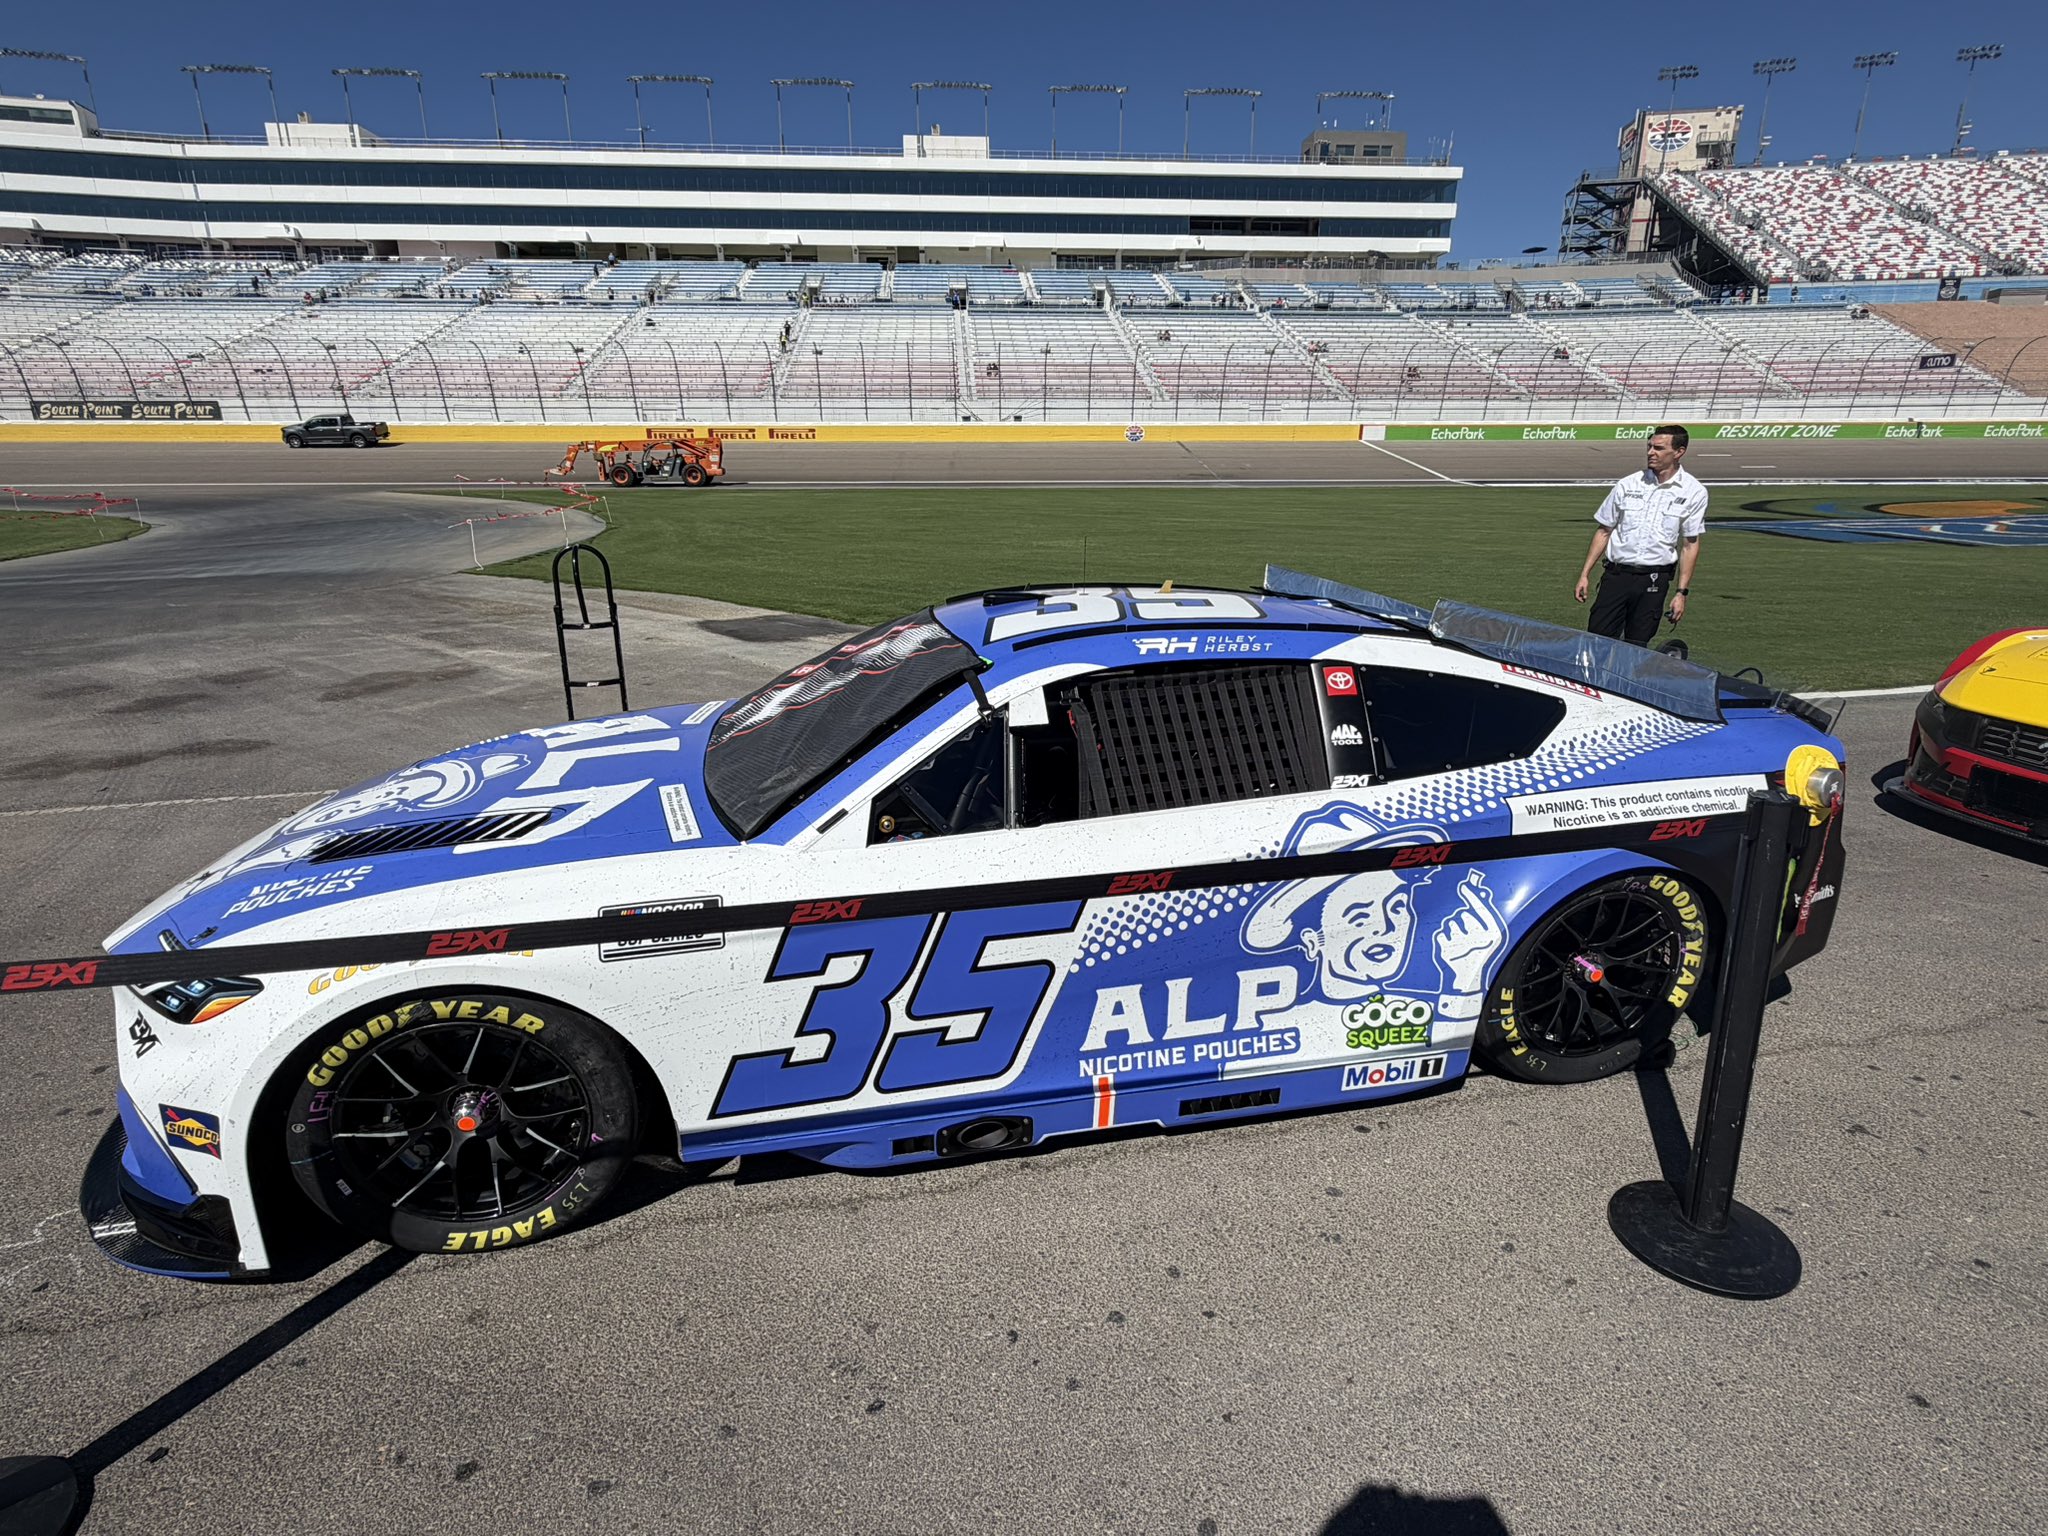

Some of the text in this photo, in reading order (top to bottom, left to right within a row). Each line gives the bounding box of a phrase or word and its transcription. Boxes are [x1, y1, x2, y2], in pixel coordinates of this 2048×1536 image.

[646, 428, 694, 439] PIRELLI
[708, 428, 756, 439] PIRELLI
[768, 428, 816, 439] PIRELLI
[1431, 428, 1485, 440] EchoPark
[1522, 428, 1577, 440] EchoPark
[1716, 424, 1843, 438] RESTART ZONE
[1984, 423, 2045, 437] EchoPark
[984, 587, 1267, 645] 35
[1132, 636, 1198, 655] RH
[1204, 643, 1273, 653] HERBST
[1206, 635, 1257, 644] RILEY
[1331, 723, 1363, 740] MAC
[1525, 801, 1588, 816] WARNING:
[1590, 797, 1617, 810] This
[1619, 792, 1664, 809] product
[1666, 788, 1712, 802] contains
[1553, 799, 1741, 828] Nicotine is an addictive chemical.
[220, 876, 365, 919] POUCHES
[708, 900, 1087, 1120] 35
[1079, 965, 1299, 1051] ALP
[1342, 999, 1432, 1029] GOGO
[1500, 987, 1529, 1056] EAGLE
[1079, 1032, 1297, 1077] NICOTINE POUCHES
[1345, 1060, 1416, 1087] Mobil
[168, 1123, 219, 1143] SUNOCO
[442, 1206, 558, 1250] EAGLE
